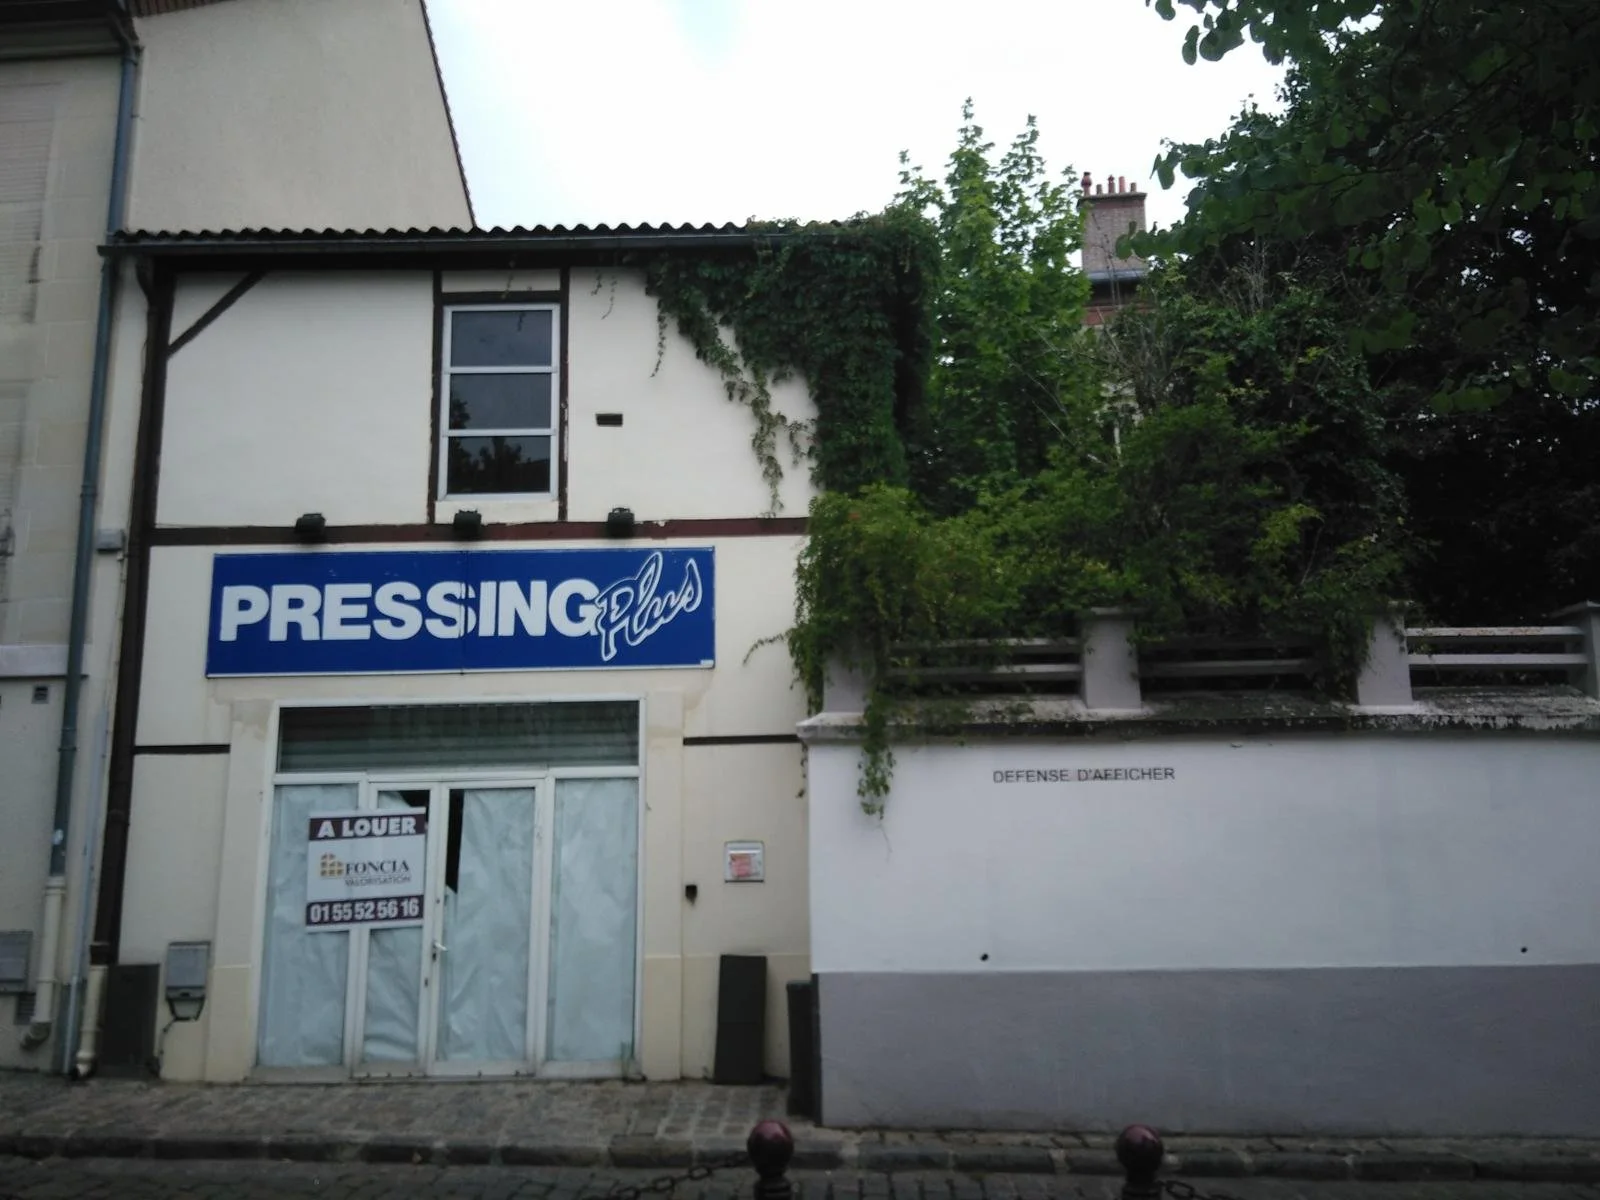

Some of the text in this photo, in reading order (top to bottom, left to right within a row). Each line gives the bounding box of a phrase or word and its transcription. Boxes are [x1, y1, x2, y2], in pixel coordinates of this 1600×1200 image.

[219, 578, 598, 642] PRESSING
[993, 769, 1069, 783] DEFENSE
[317, 817, 416, 838] A LOUER
[346, 860, 409, 875] FONCIA
